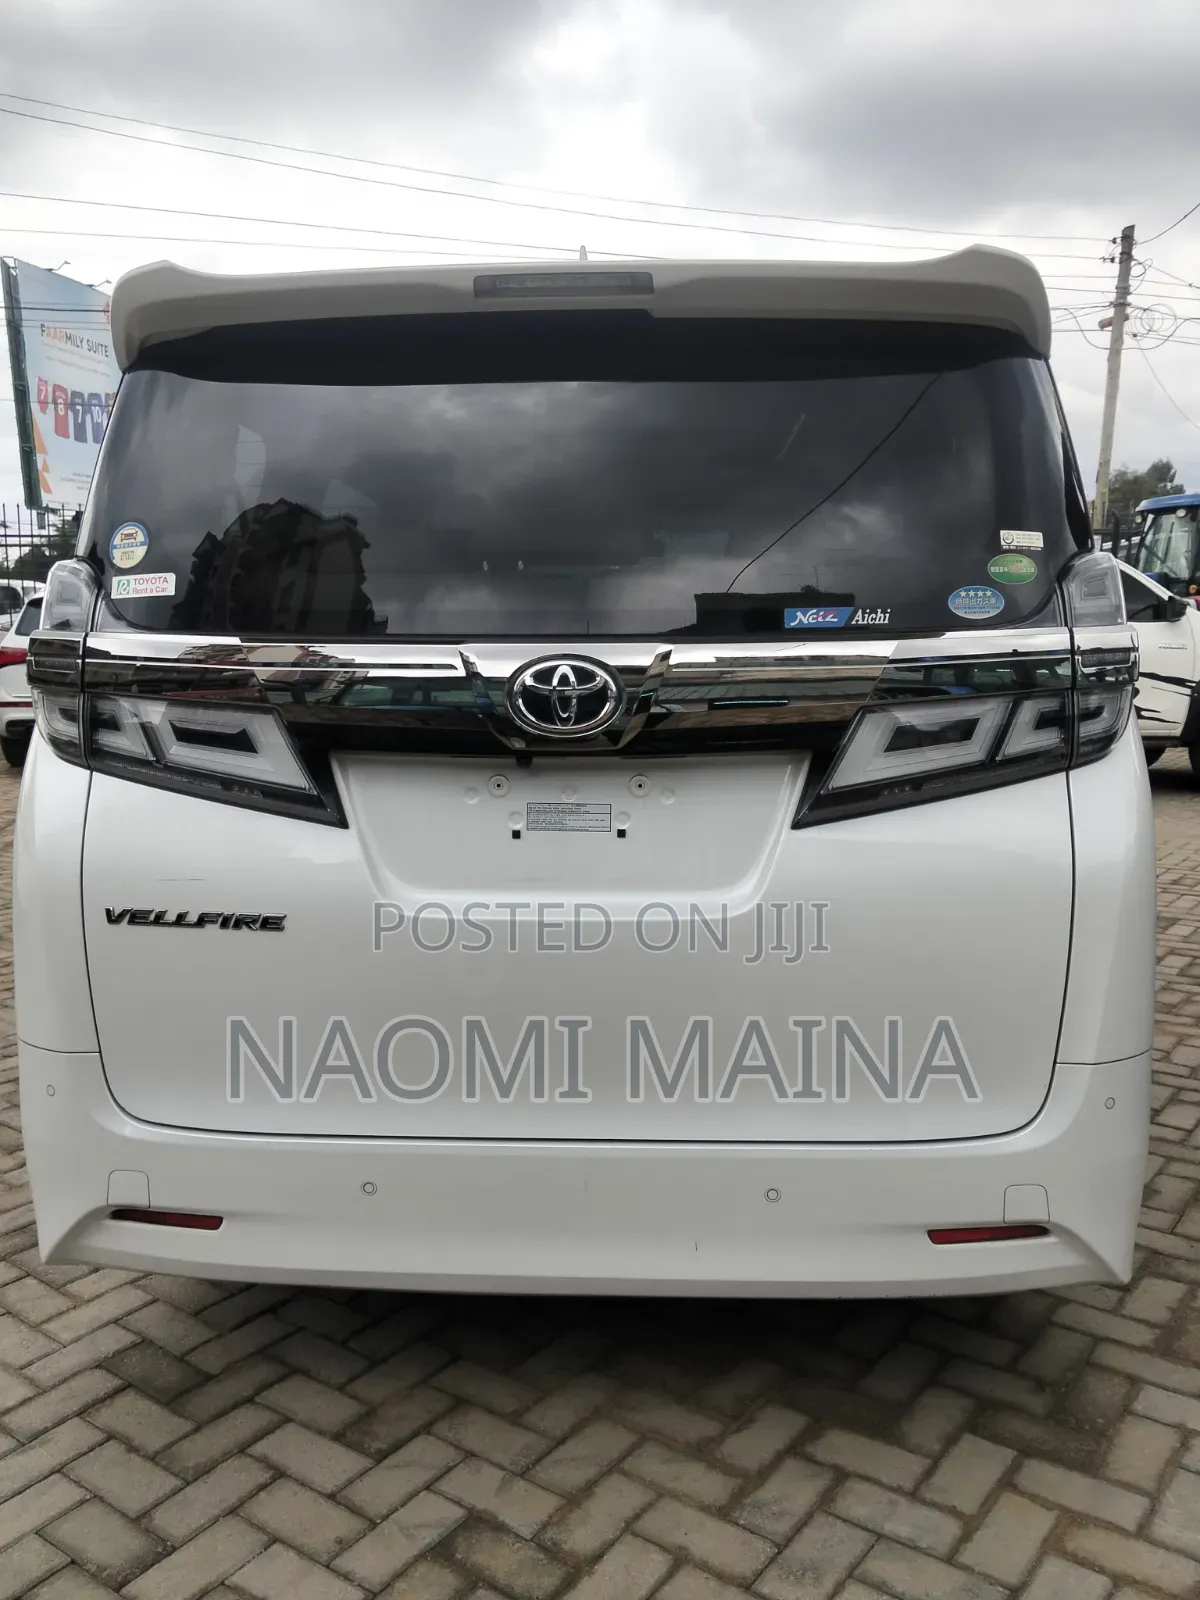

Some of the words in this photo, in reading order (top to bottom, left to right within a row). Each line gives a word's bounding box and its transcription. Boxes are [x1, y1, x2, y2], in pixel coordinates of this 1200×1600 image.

[86, 338, 109, 358] SUITE
[40, 385, 46, 400] 7
[57, 398, 65, 416] 8
[75, 405, 83, 424] 7
[91, 405, 102, 424] 10
[132, 587, 148, 595] Rent
[155, 585, 169, 593] Car
[133, 576, 169, 586] TOYOTA
[851, 608, 891, 624] Aichi
[104, 906, 287, 932] VELLFIRE
